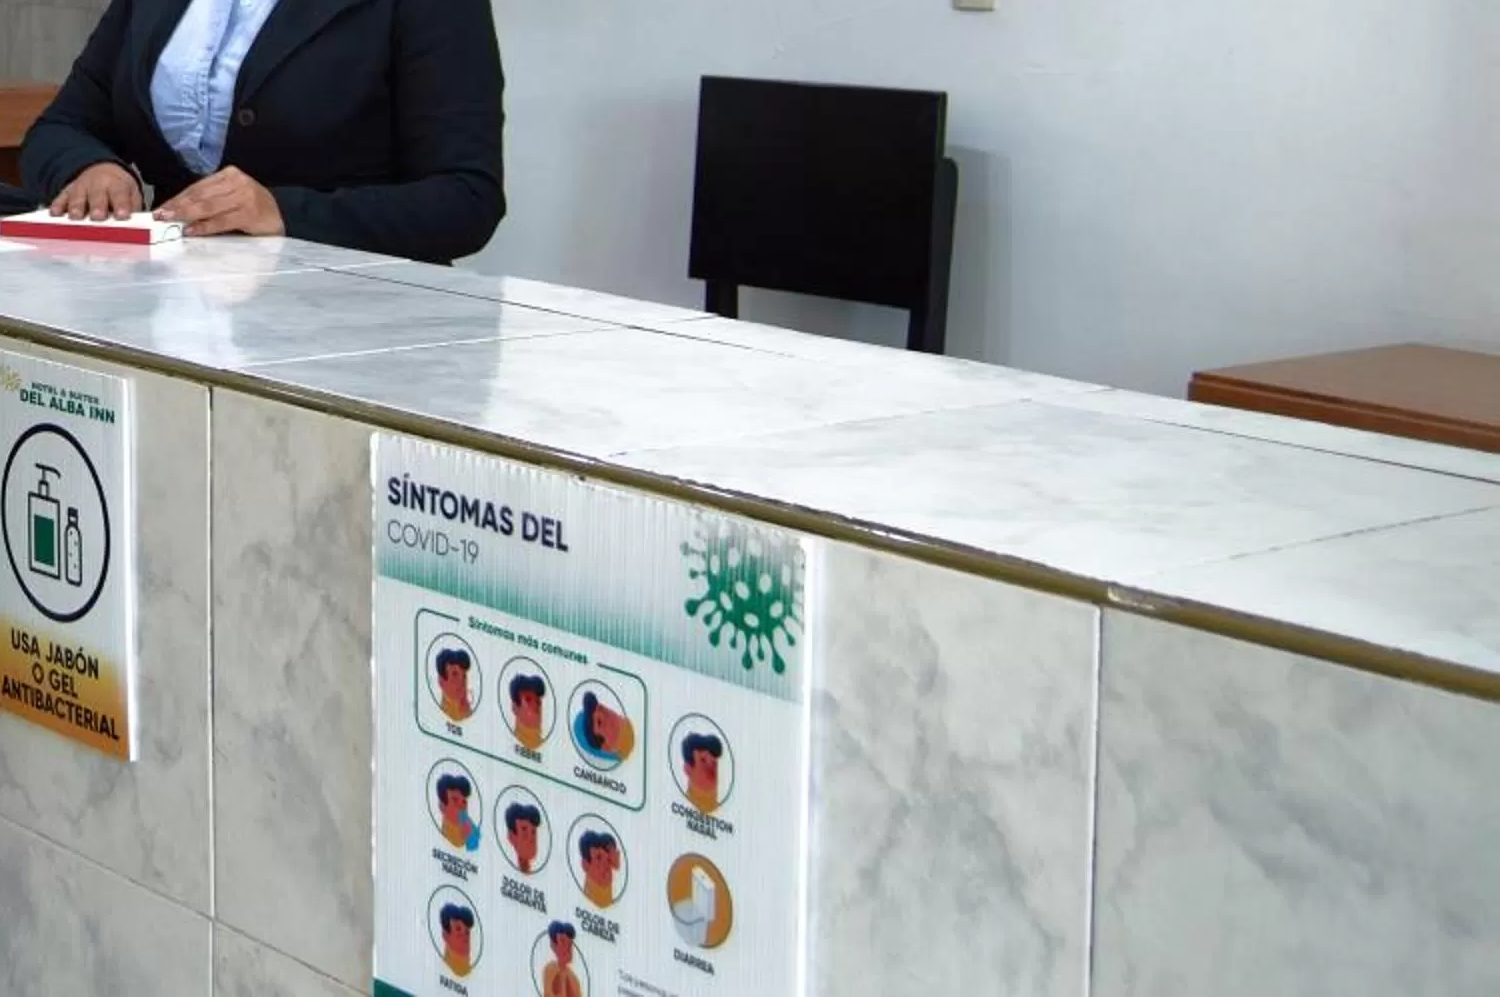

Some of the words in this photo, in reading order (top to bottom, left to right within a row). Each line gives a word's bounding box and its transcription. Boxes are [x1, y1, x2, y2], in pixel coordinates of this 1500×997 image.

[19, 388, 46, 408] DEL
[49, 396, 85, 417] ALBA
[88, 405, 115, 424] INN
[387, 472, 514, 536] SÍNTOMAS
[521, 511, 569, 553] DEL
[387, 519, 480, 565] COVID-19
[11, 627, 40, 659] USA
[45, 641, 99, 680] JABÓN
[31, 662, 45, 684] O
[49, 668, 78, 699] GEL
[2, 674, 120, 741] ANTIBACTERIAL
[573, 766, 627, 795] CANSANCIO
